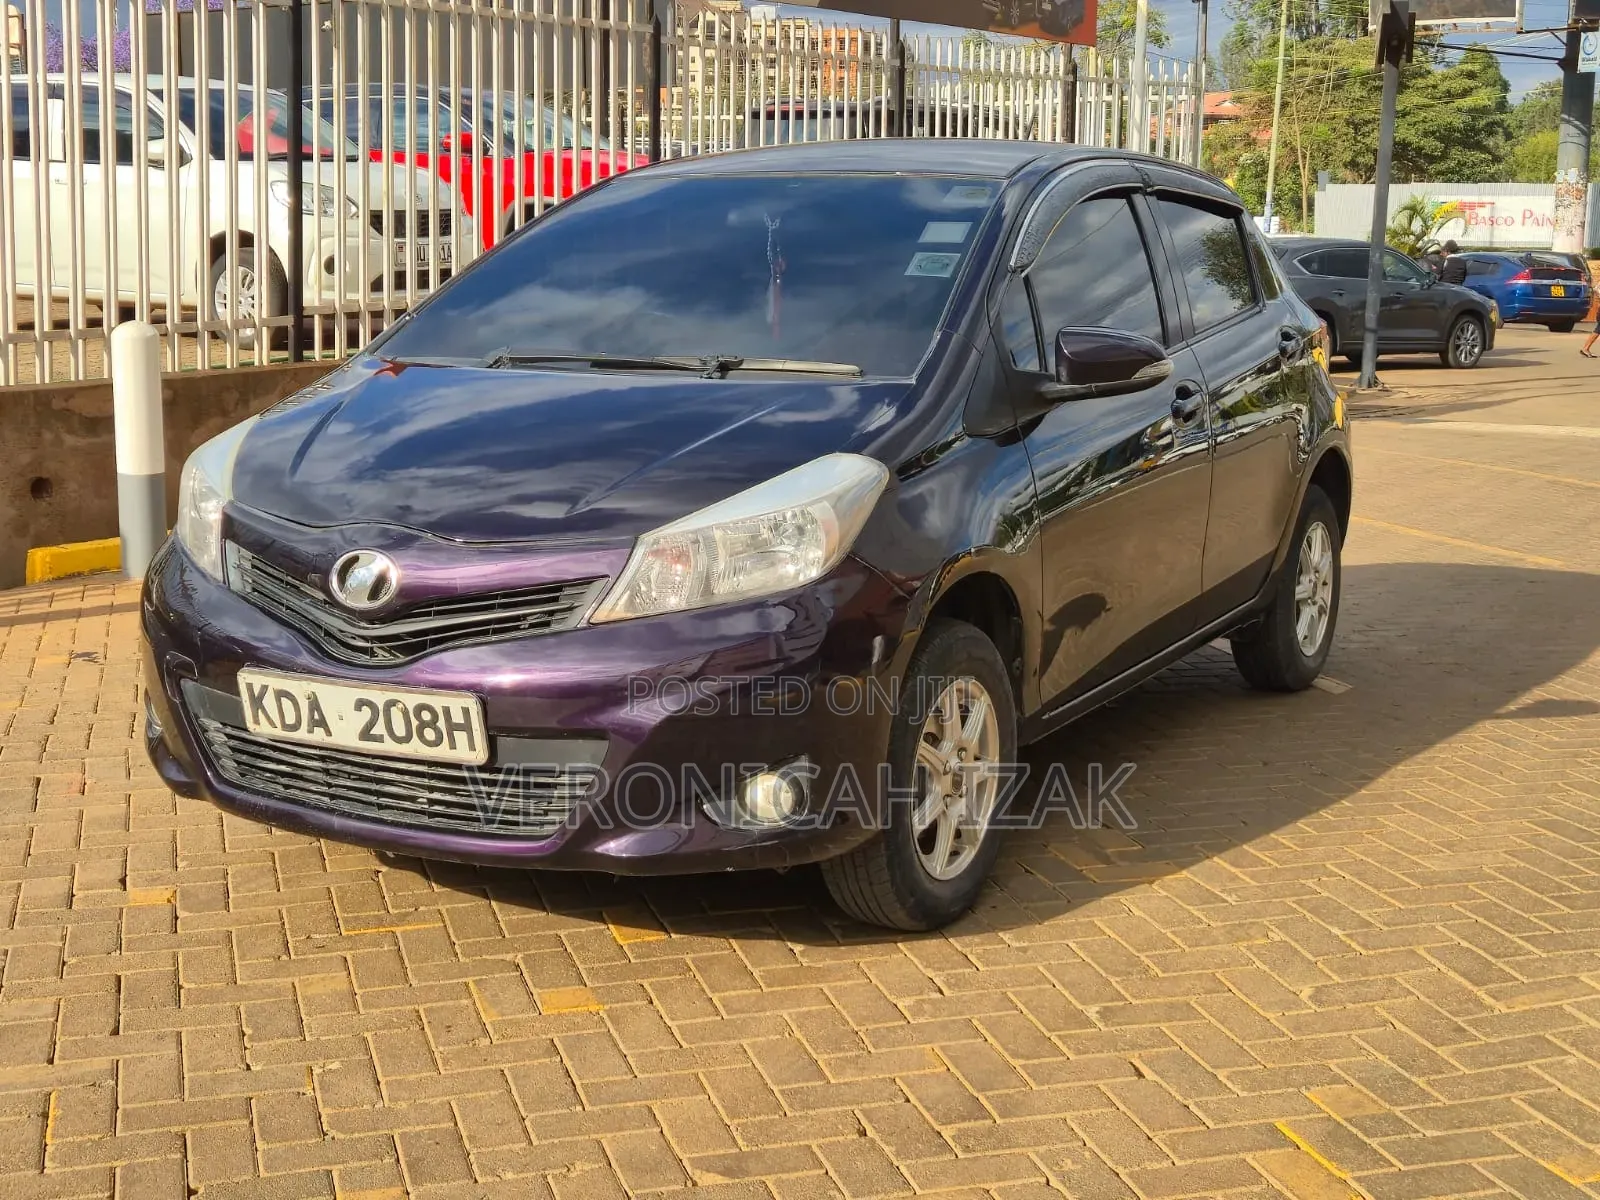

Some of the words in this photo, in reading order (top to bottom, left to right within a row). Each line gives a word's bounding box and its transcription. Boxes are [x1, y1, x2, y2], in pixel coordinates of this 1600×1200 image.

[1468, 211, 1515, 227] BASCO
[245, 682, 333, 737] KDA
[353, 697, 477, 753] 208H
